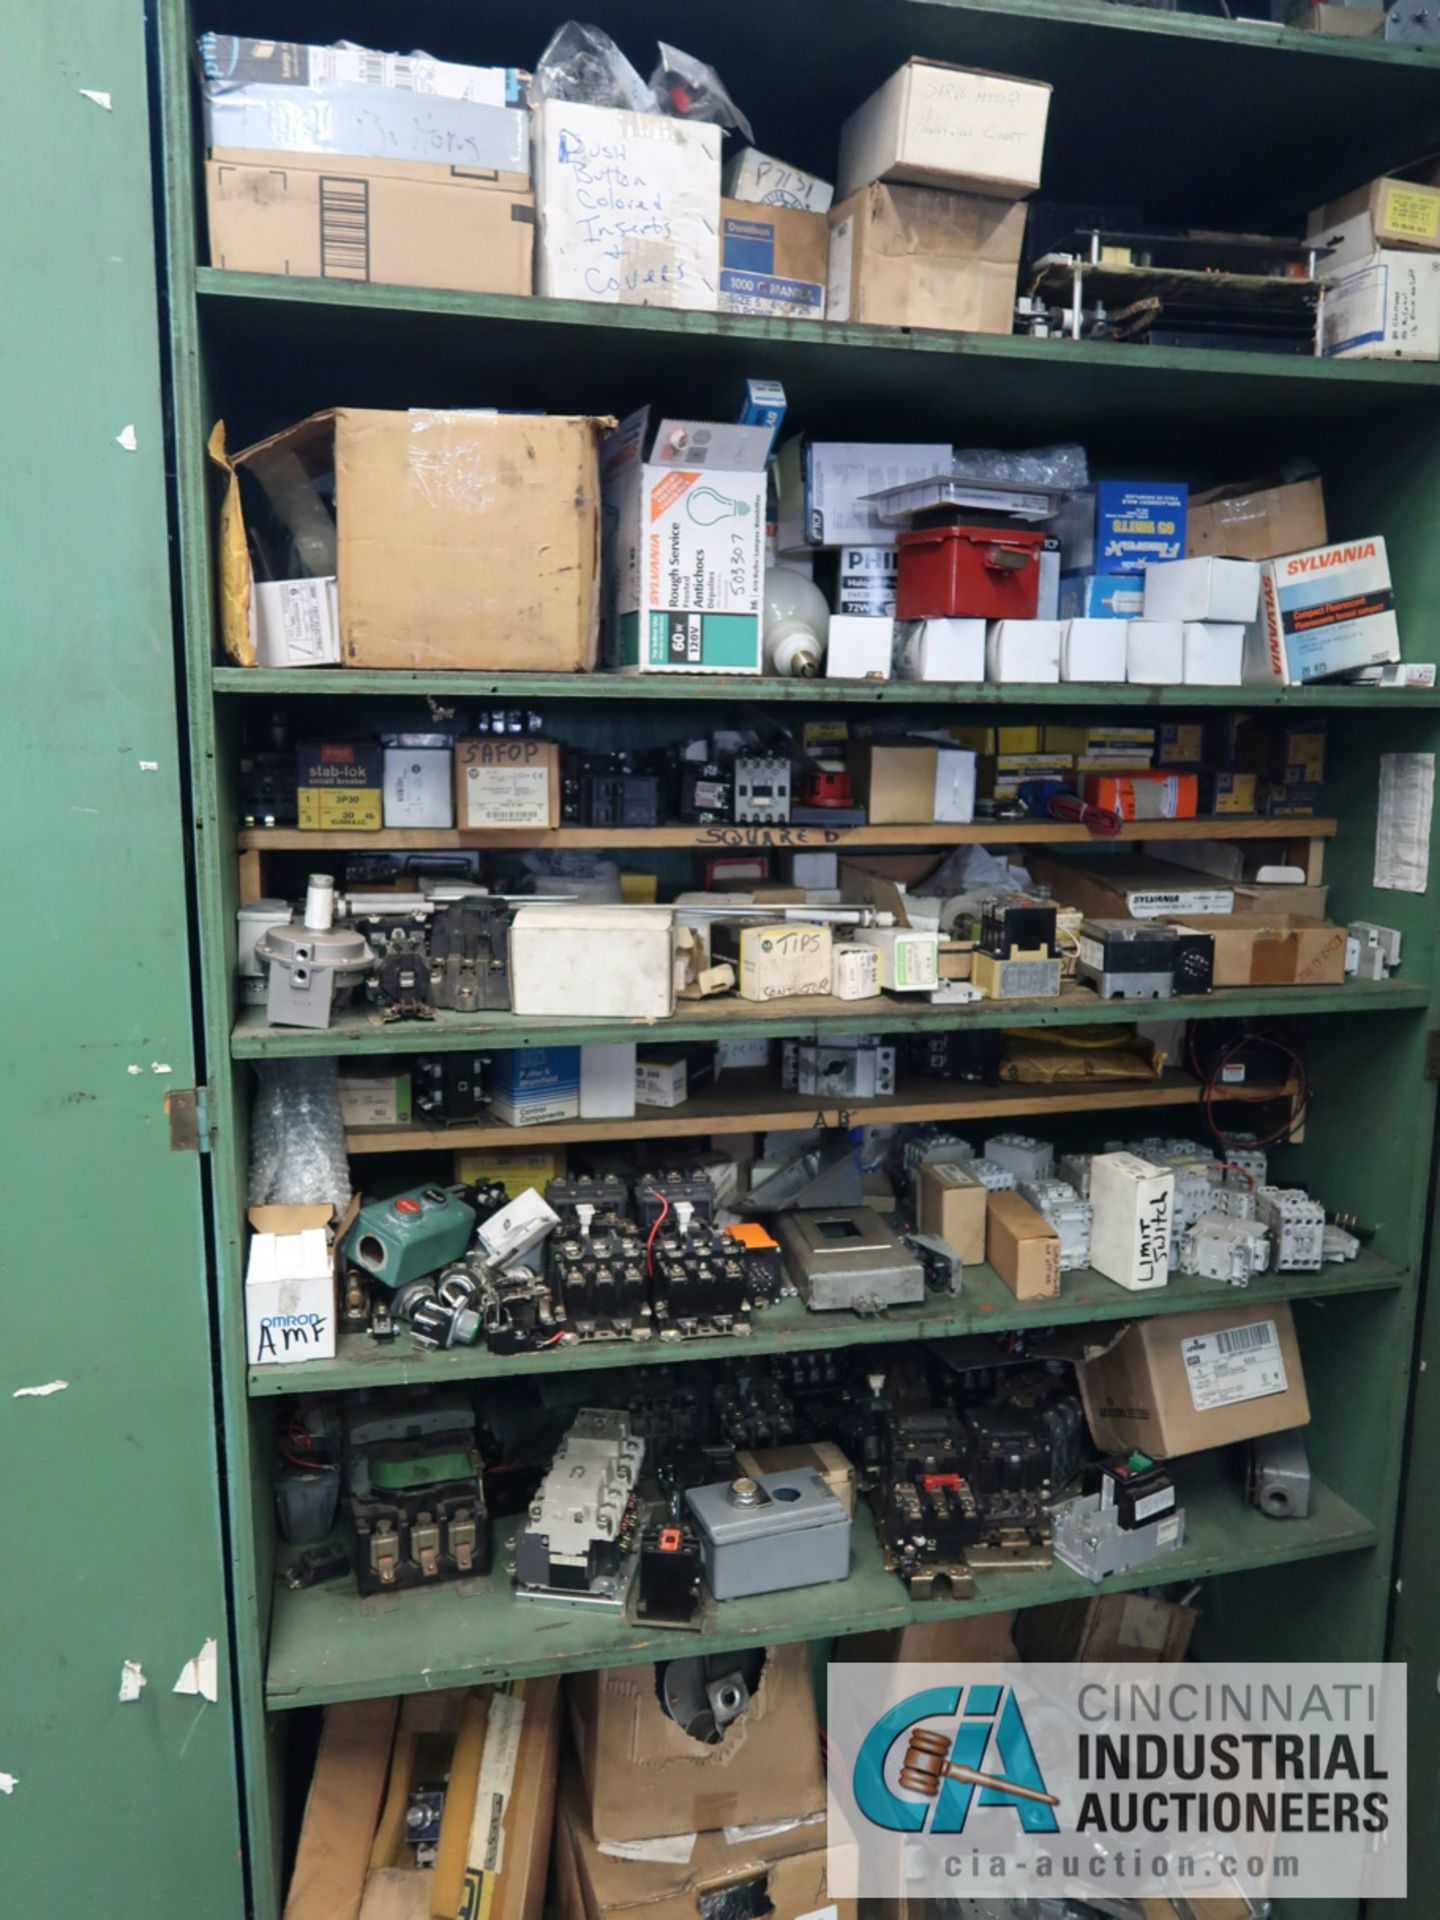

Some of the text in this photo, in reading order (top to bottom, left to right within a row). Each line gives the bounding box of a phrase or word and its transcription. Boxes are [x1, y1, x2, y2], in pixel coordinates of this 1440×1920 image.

[650, 533, 660, 606] SYLVANIA
[668, 522, 682, 608] Rough Service
[1287, 543, 1377, 576] SYLVANIA
[693, 549, 705, 609] Antichocs
[690, 626, 699, 653] 120V
[1262, 575, 1282, 676] SYLVANIA
[462, 742, 539, 763] SAFOP
[309, 765, 367, 778] stab-lok
[696, 828, 841, 846] SQUARE D
[776, 932, 822, 955] TIPS
